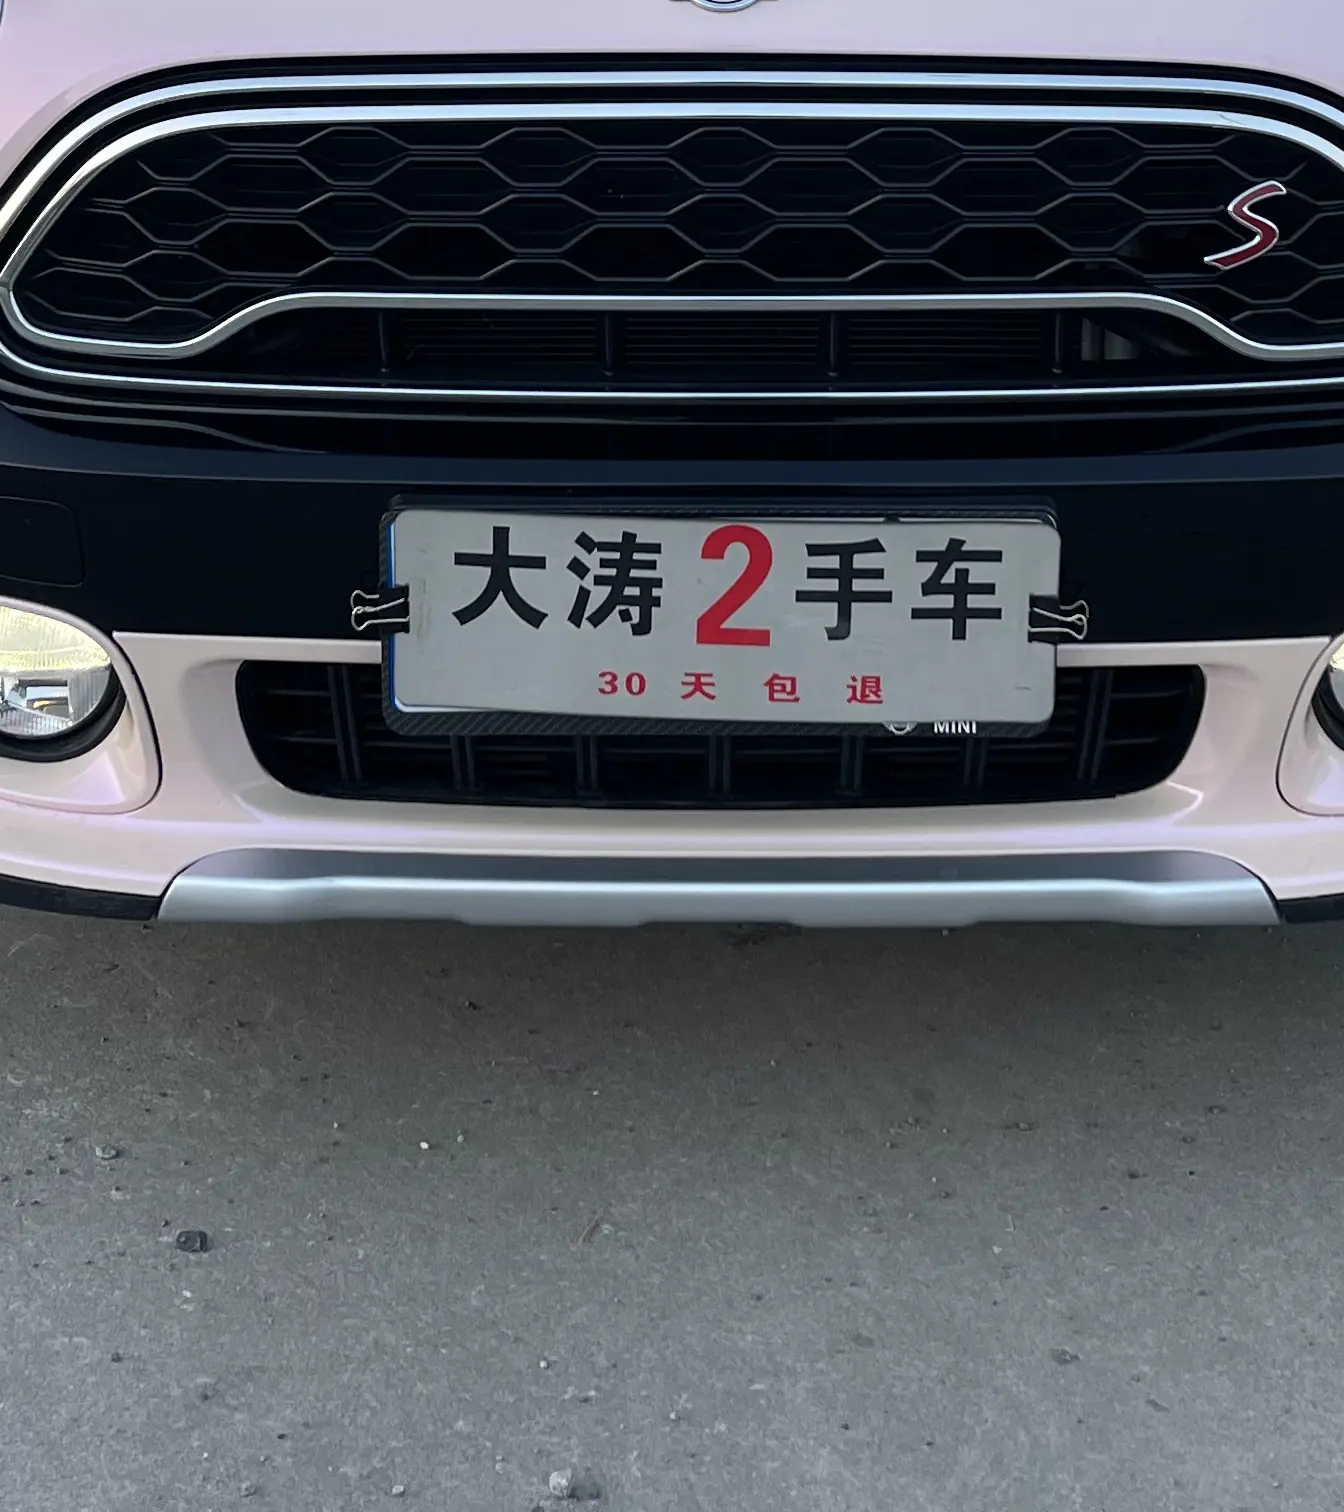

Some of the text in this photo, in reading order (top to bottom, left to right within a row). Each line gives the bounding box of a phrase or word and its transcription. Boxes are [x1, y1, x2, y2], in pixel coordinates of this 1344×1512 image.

[1203, 180, 1288, 270] S
[452, 524, 1003, 647] 大涛2手车
[597, 671, 885, 705] 30天包退
[933, 720, 977, 735] MINI
